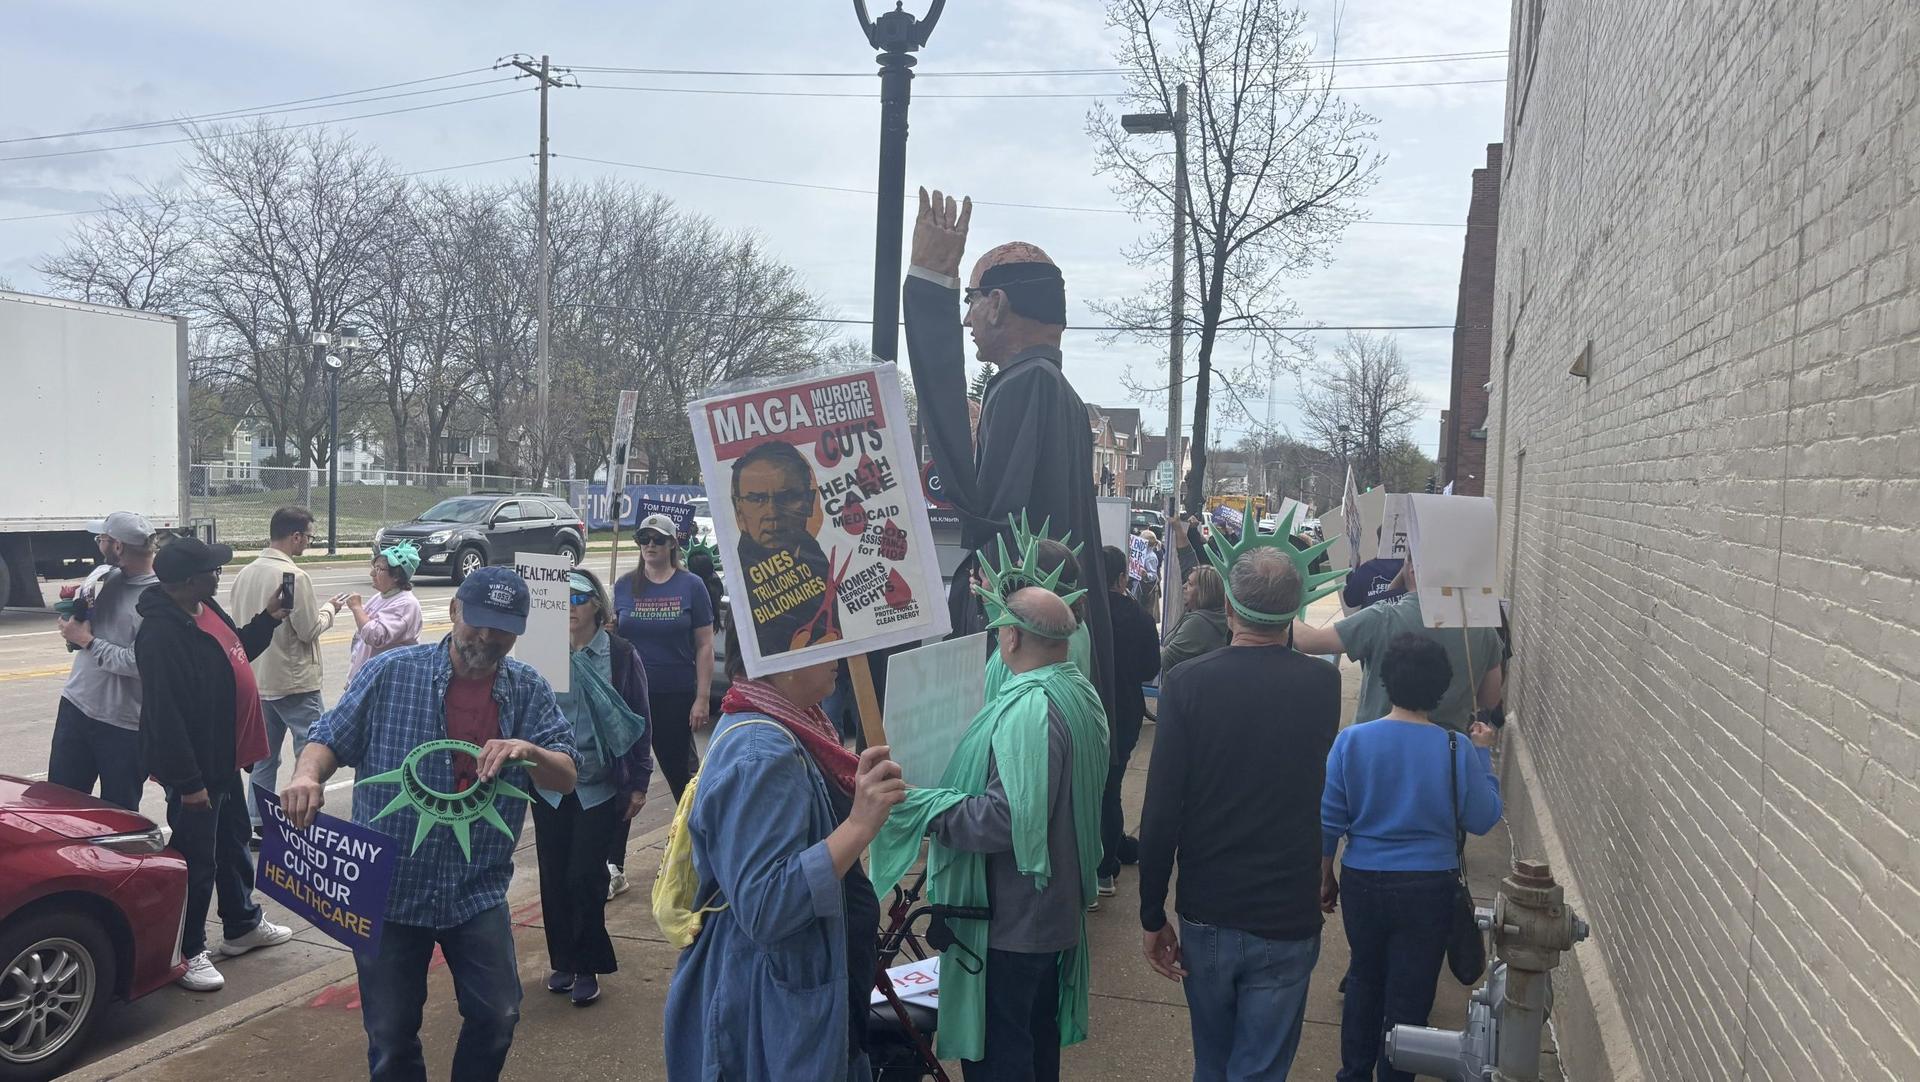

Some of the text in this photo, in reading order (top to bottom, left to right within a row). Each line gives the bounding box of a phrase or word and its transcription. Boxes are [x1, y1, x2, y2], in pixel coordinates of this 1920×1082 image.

[810, 380, 871, 408] MURDER
[712, 394, 812, 445] MAGA
[813, 398, 875, 426] REGIME
[822, 420, 882, 460] CUTS
[819, 456, 891, 500] HEALTH
[825, 472, 897, 516] CARE
[643, 503, 659, 511] TOM
[661, 506, 690, 515] TIFFANY
[832, 505, 899, 528] MEDICAID
[864, 523, 907, 538] FOOD
[858, 544, 874, 555] for
[515, 564, 570, 583] HEALTHCARE
[749, 550, 794, 583] GIVES
[753, 563, 812, 603] TRILLIONS TO
[836, 562, 886, 596] WOMEN'S
[531, 588, 548, 596] NOT
[531, 598, 567, 610] LTHCARE
[754, 576, 826, 624] BILLIONAIRES
[841, 572, 888, 603] REPRODUCTIVE
[846, 581, 895, 614] RIGHTS
[874, 604, 914, 618] PROTECTIONS
[876, 610, 920, 626] CLEAN ENERGY
[264, 798, 298, 831] TO
[279, 824, 360, 882] VOTED TO
[284, 850, 351, 906] CUT OUR
[265, 861, 372, 938] HEALTHCARE
